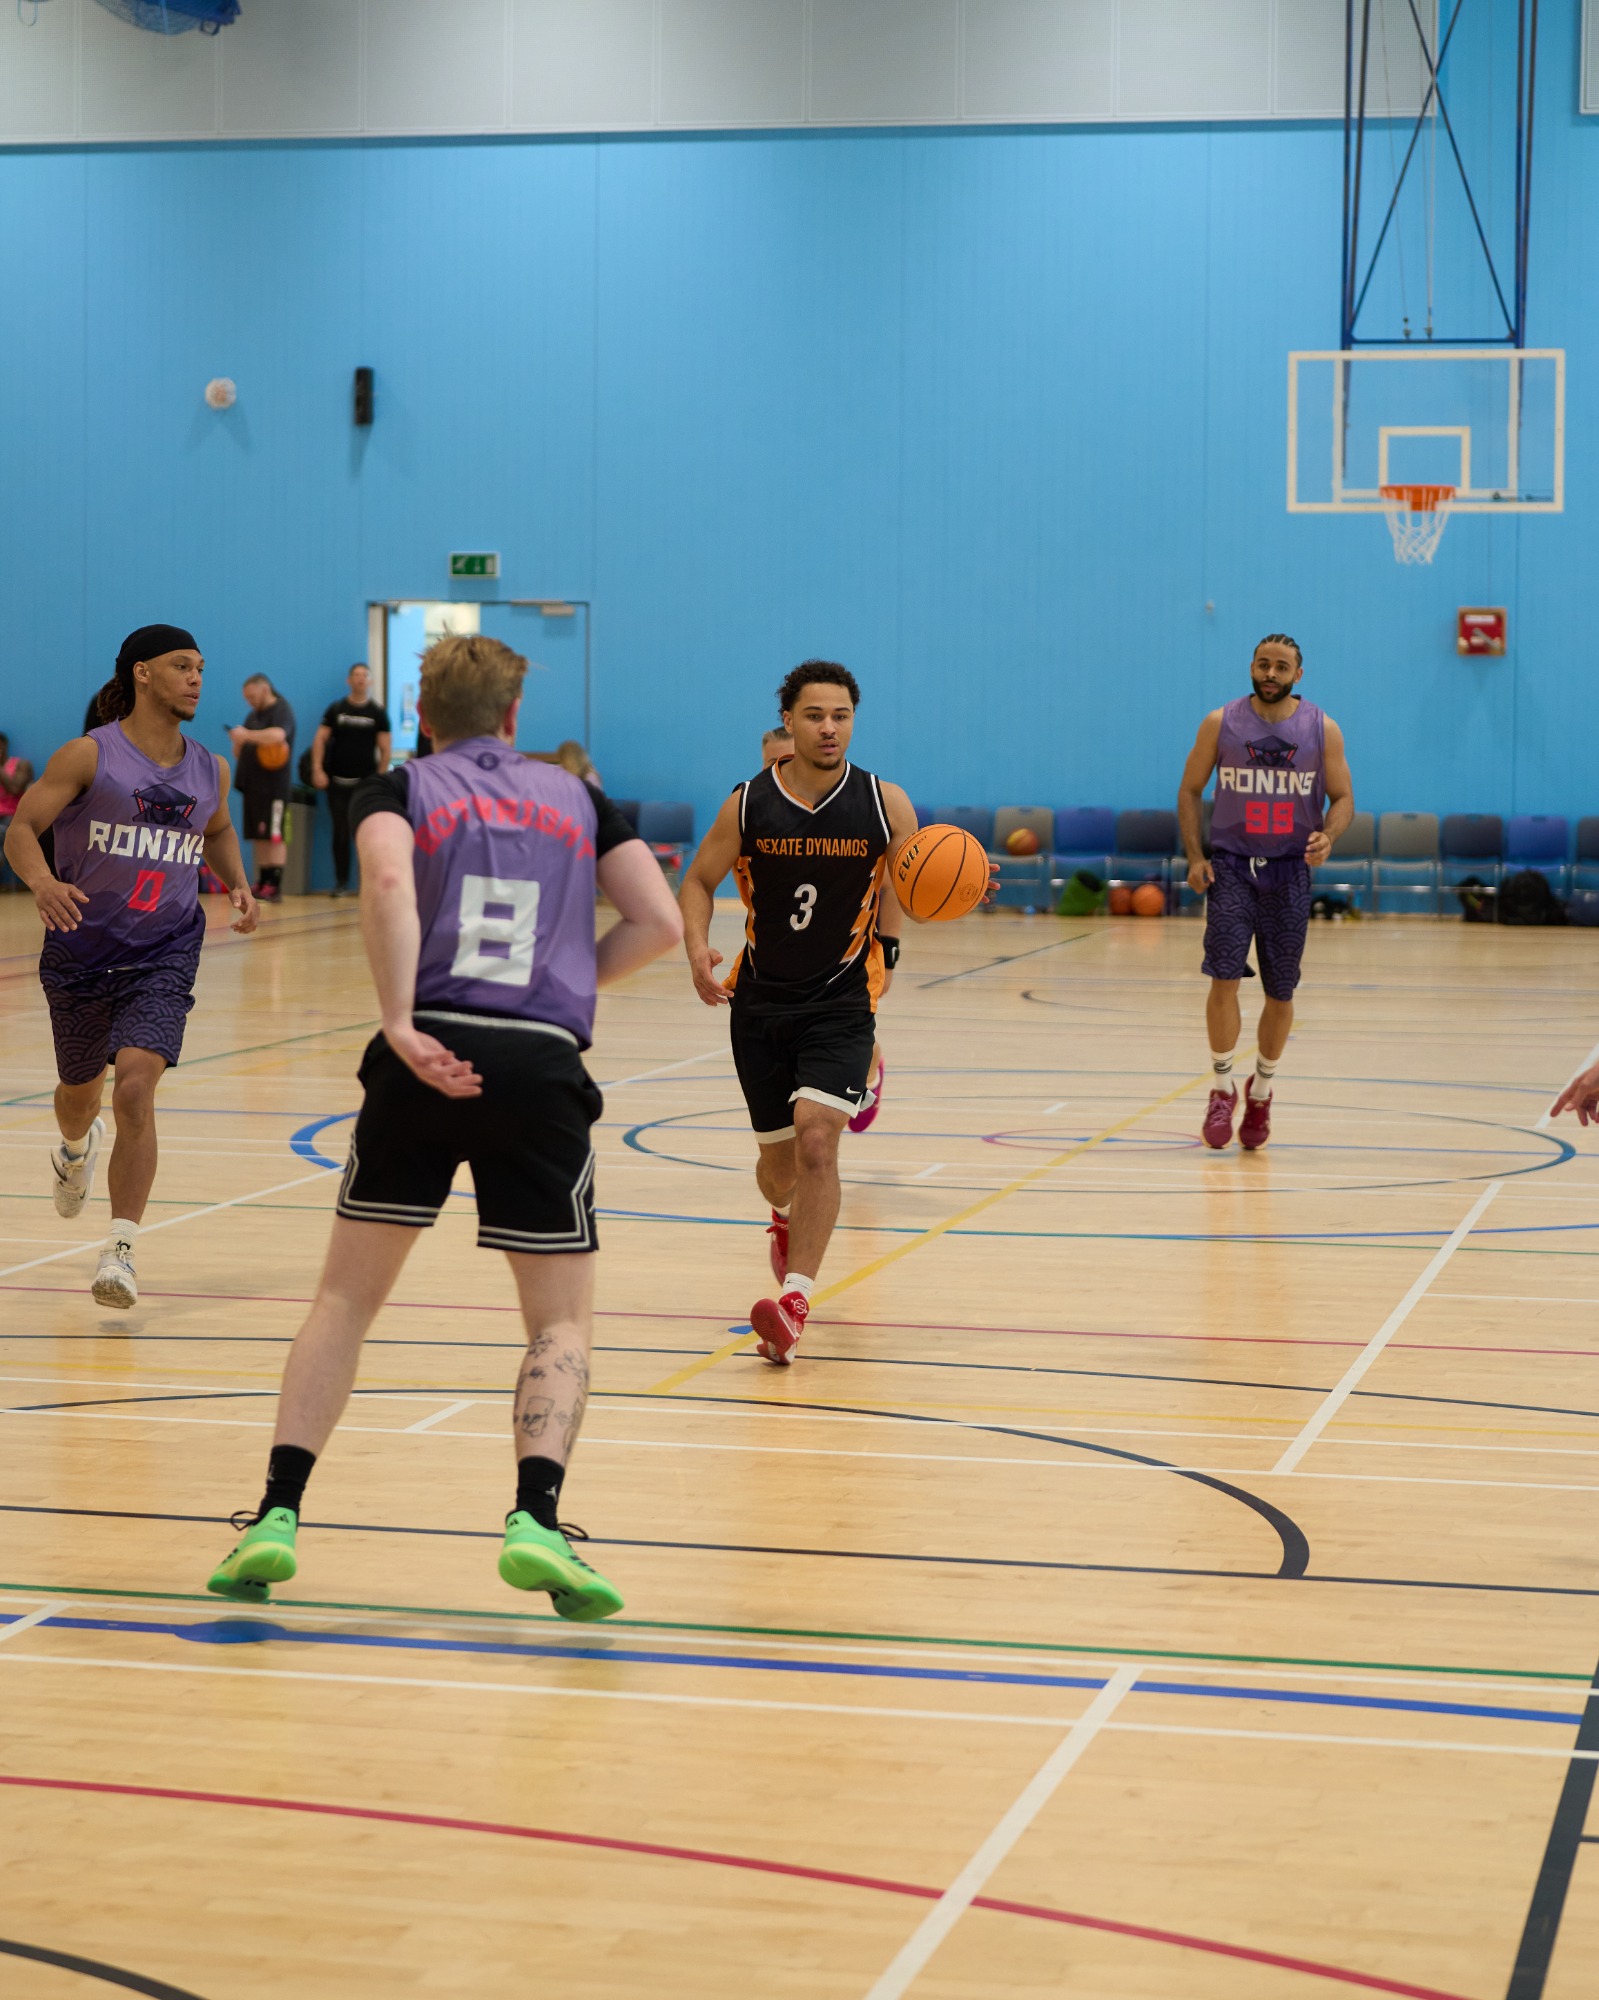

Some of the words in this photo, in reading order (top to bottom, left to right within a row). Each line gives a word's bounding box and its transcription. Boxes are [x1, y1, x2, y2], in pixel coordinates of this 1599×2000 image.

[1220, 766, 1316, 796] RONINS
[1245, 801, 1295, 835] 99
[805, 838, 869, 857] DYNAMOS
[789, 883, 818, 931] 3
[450, 874, 540, 987] 8
